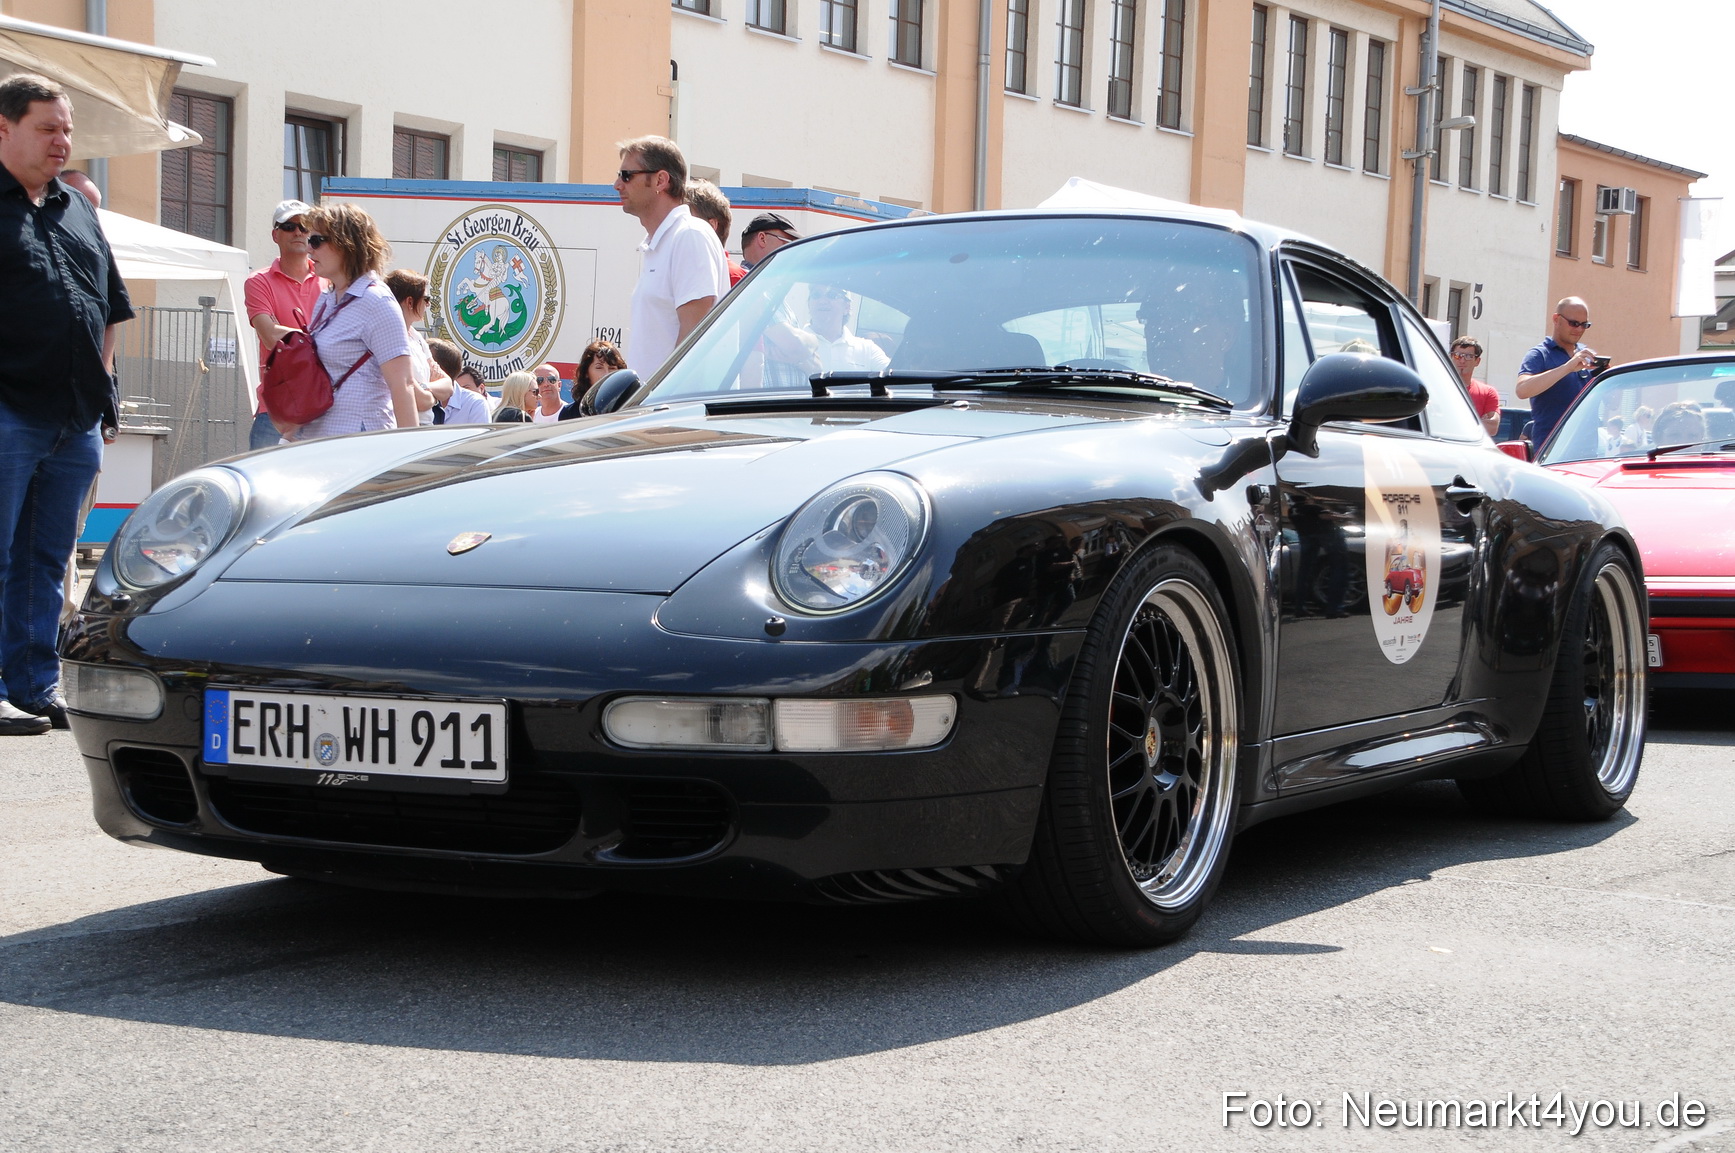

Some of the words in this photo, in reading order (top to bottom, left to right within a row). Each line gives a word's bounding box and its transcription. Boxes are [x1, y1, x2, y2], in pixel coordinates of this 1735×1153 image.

[446, 229, 467, 251] St.
[463, 214, 511, 238] Georgen
[511, 215, 540, 252] Bräu
[1472, 283, 1483, 320] 5
[1382, 493, 1421, 504] PORSCHE
[1398, 504, 1408, 515] 911
[1393, 615, 1413, 625] JAHRE
[211, 733, 222, 750] D
[233, 699, 310, 759] ERH
[343, 705, 397, 765] WH
[411, 710, 498, 770] 911
